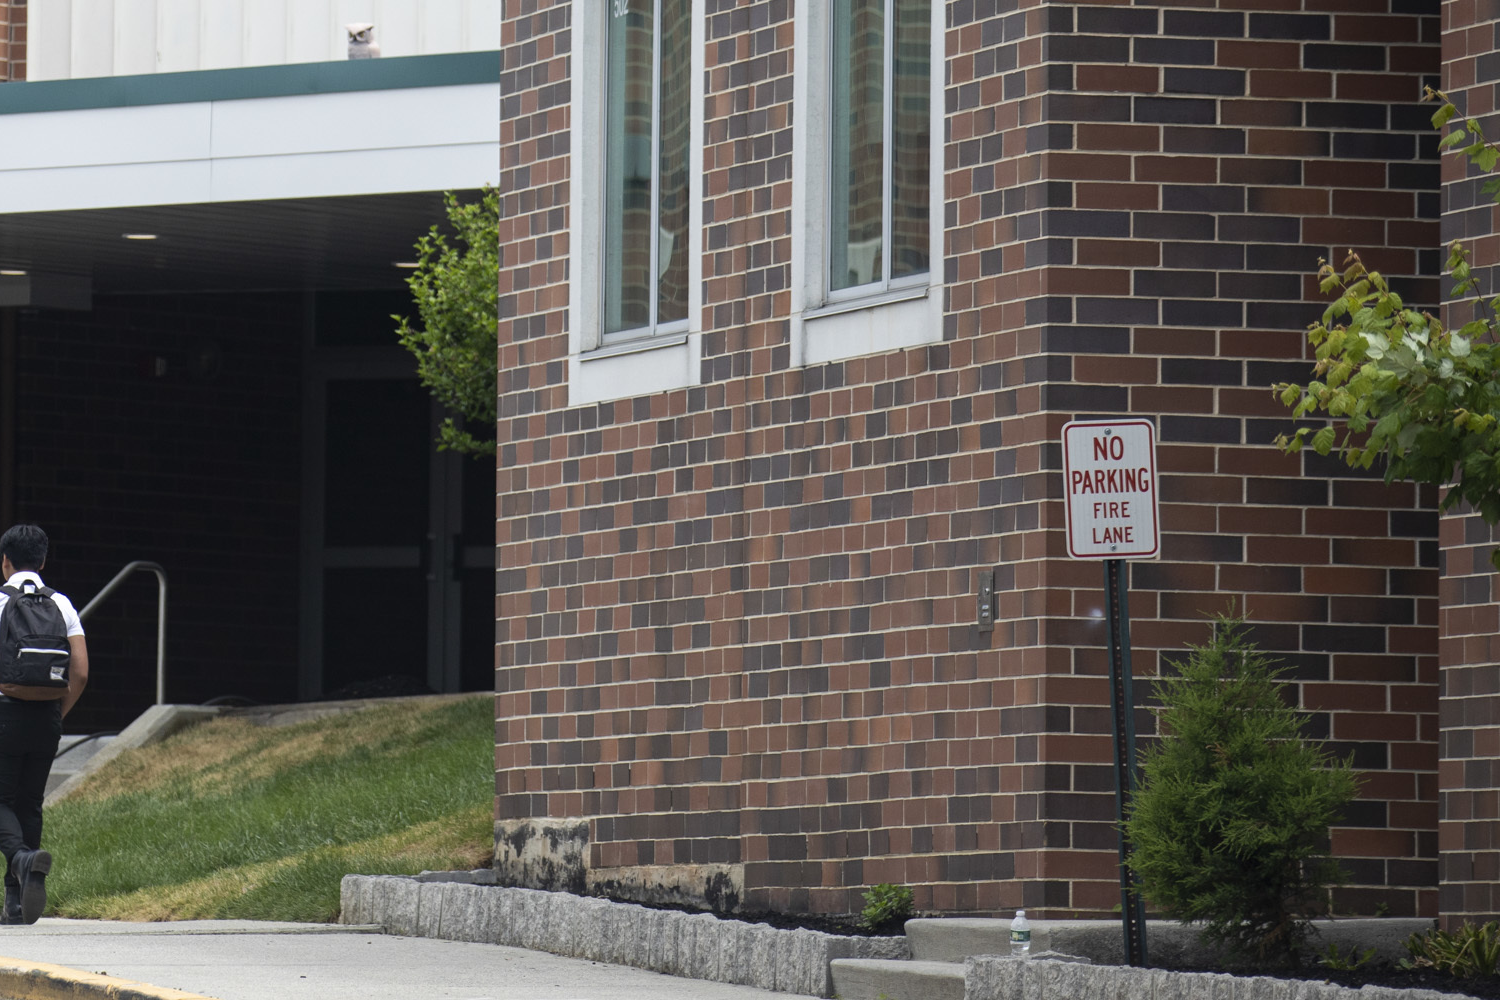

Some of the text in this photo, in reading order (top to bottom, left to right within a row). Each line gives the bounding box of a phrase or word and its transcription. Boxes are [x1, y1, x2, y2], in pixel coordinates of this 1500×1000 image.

[1093, 435, 1124, 461] NO
[1071, 467, 1150, 495] PARKING
[1093, 501, 1131, 519] FIRE
[1092, 526, 1134, 544] LANE
